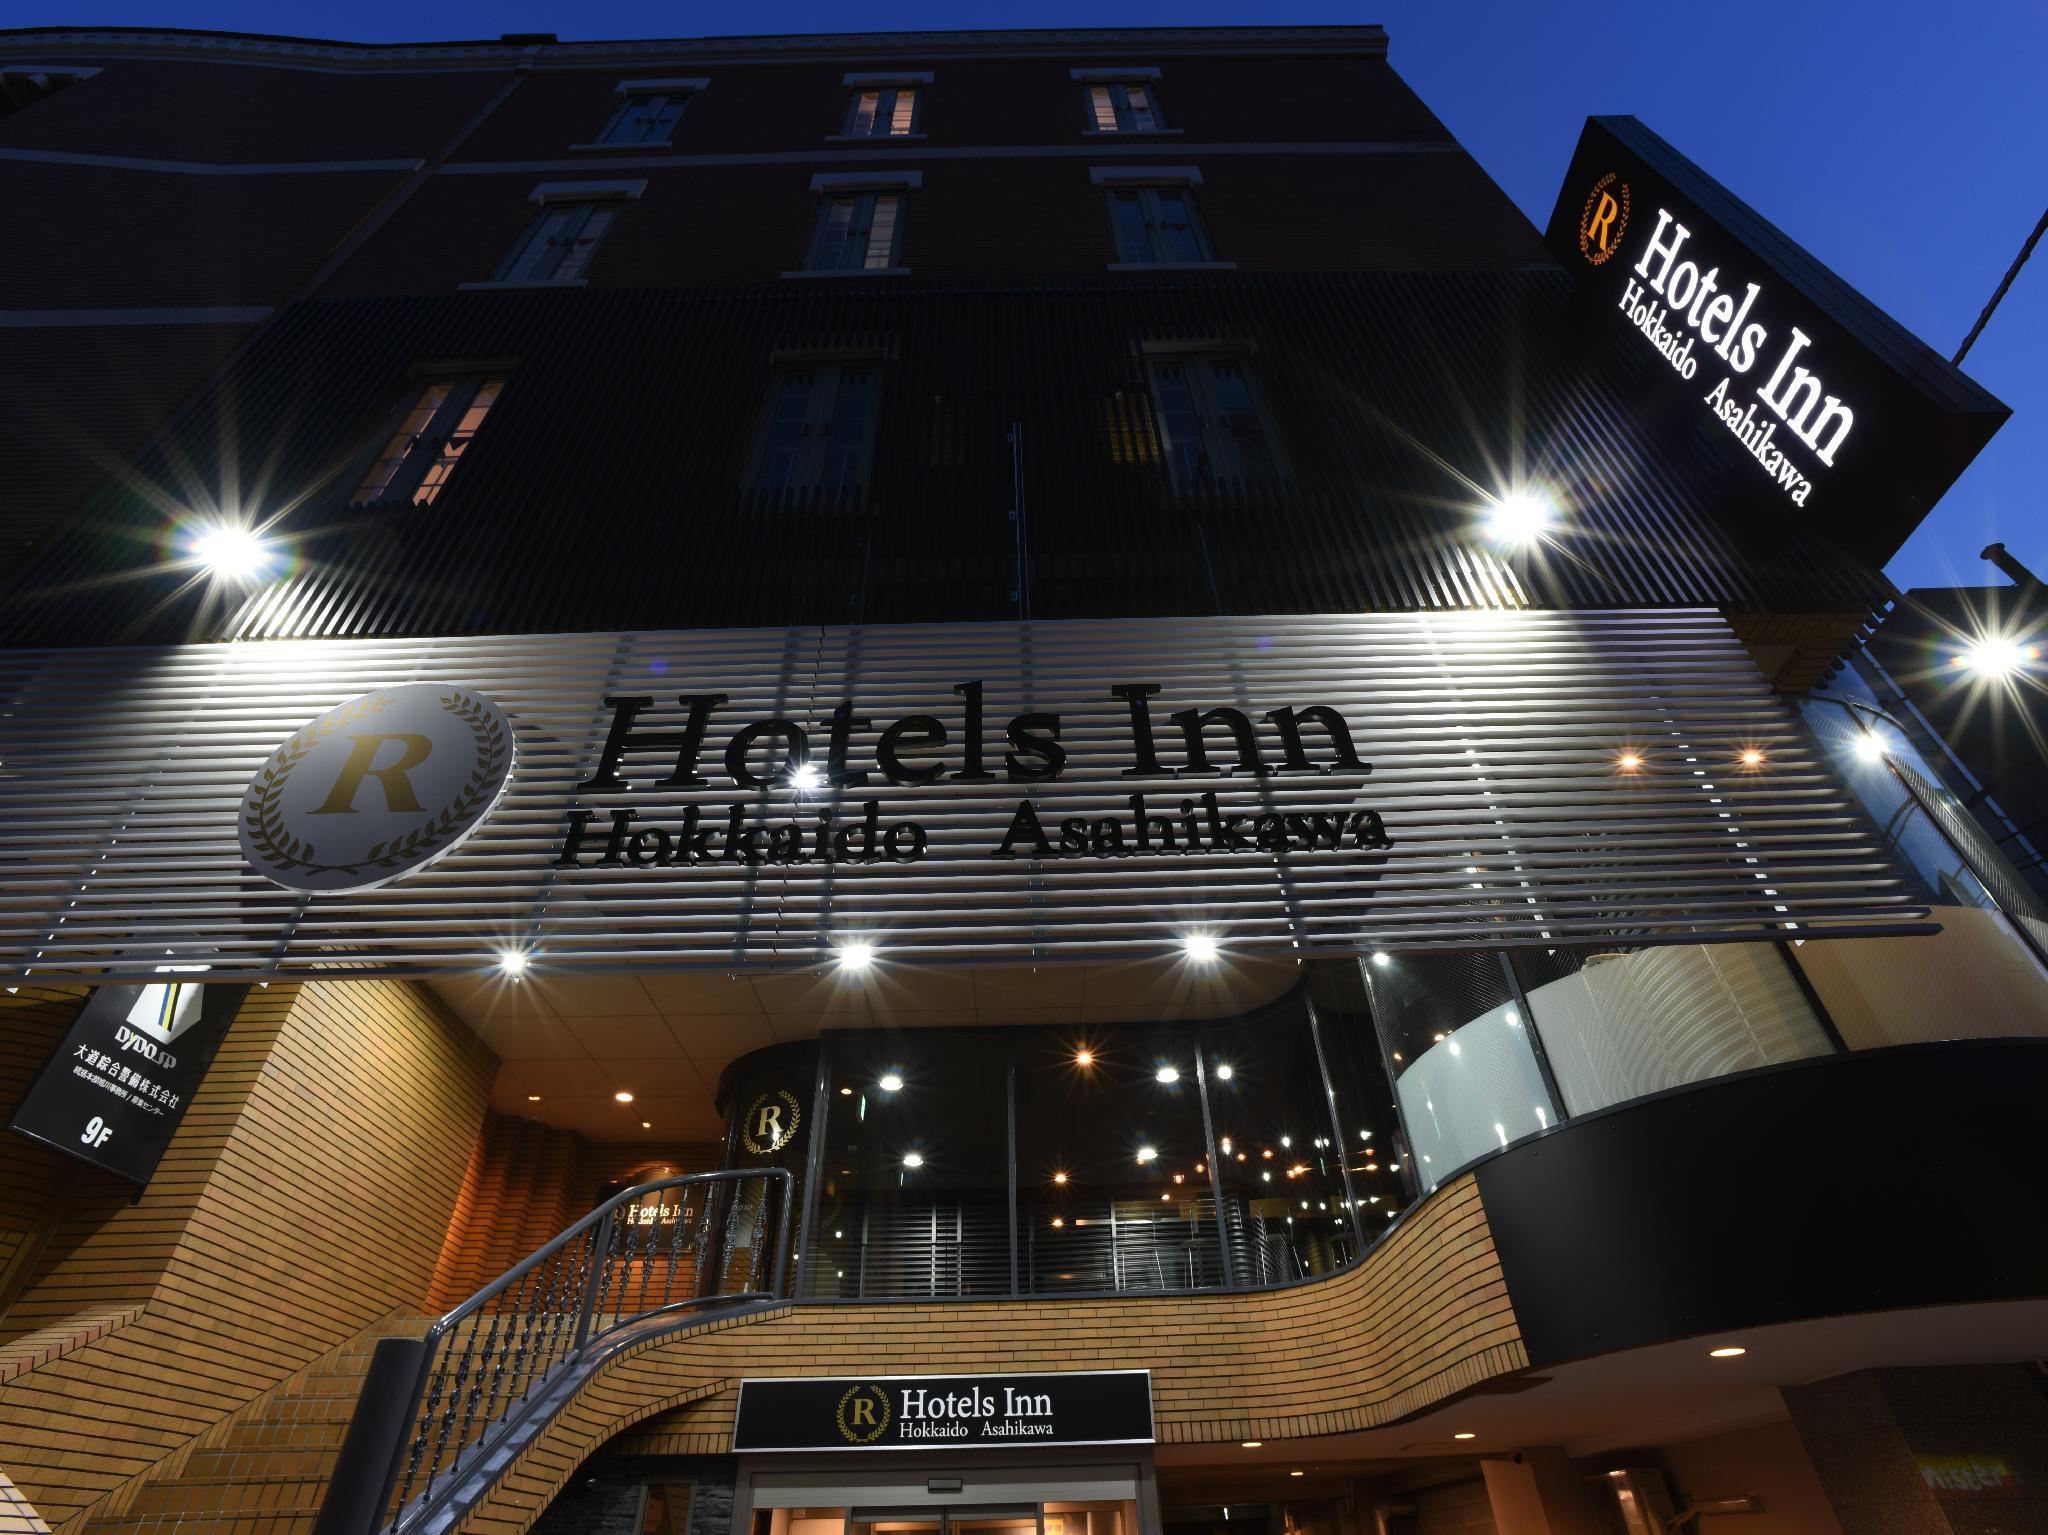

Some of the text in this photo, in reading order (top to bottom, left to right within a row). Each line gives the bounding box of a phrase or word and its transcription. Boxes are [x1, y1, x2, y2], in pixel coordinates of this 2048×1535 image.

[1587, 190, 1618, 252] R
[1634, 208, 1855, 468] Hotels Inn
[1618, 277, 1813, 507] Hokkaido Asahikawa
[576, 679, 1373, 787] Hotels Inn
[306, 732, 434, 815] R
[552, 792, 1395, 870] Hokkaido Asahikawa
[80, 1116, 114, 1148] 9F
[756, 1104, 784, 1137] R
[850, 1398, 877, 1425] R
[900, 1386, 1053, 1419] Hotels Inn
[900, 1420, 1054, 1438] Hokkaido Asahikawa
